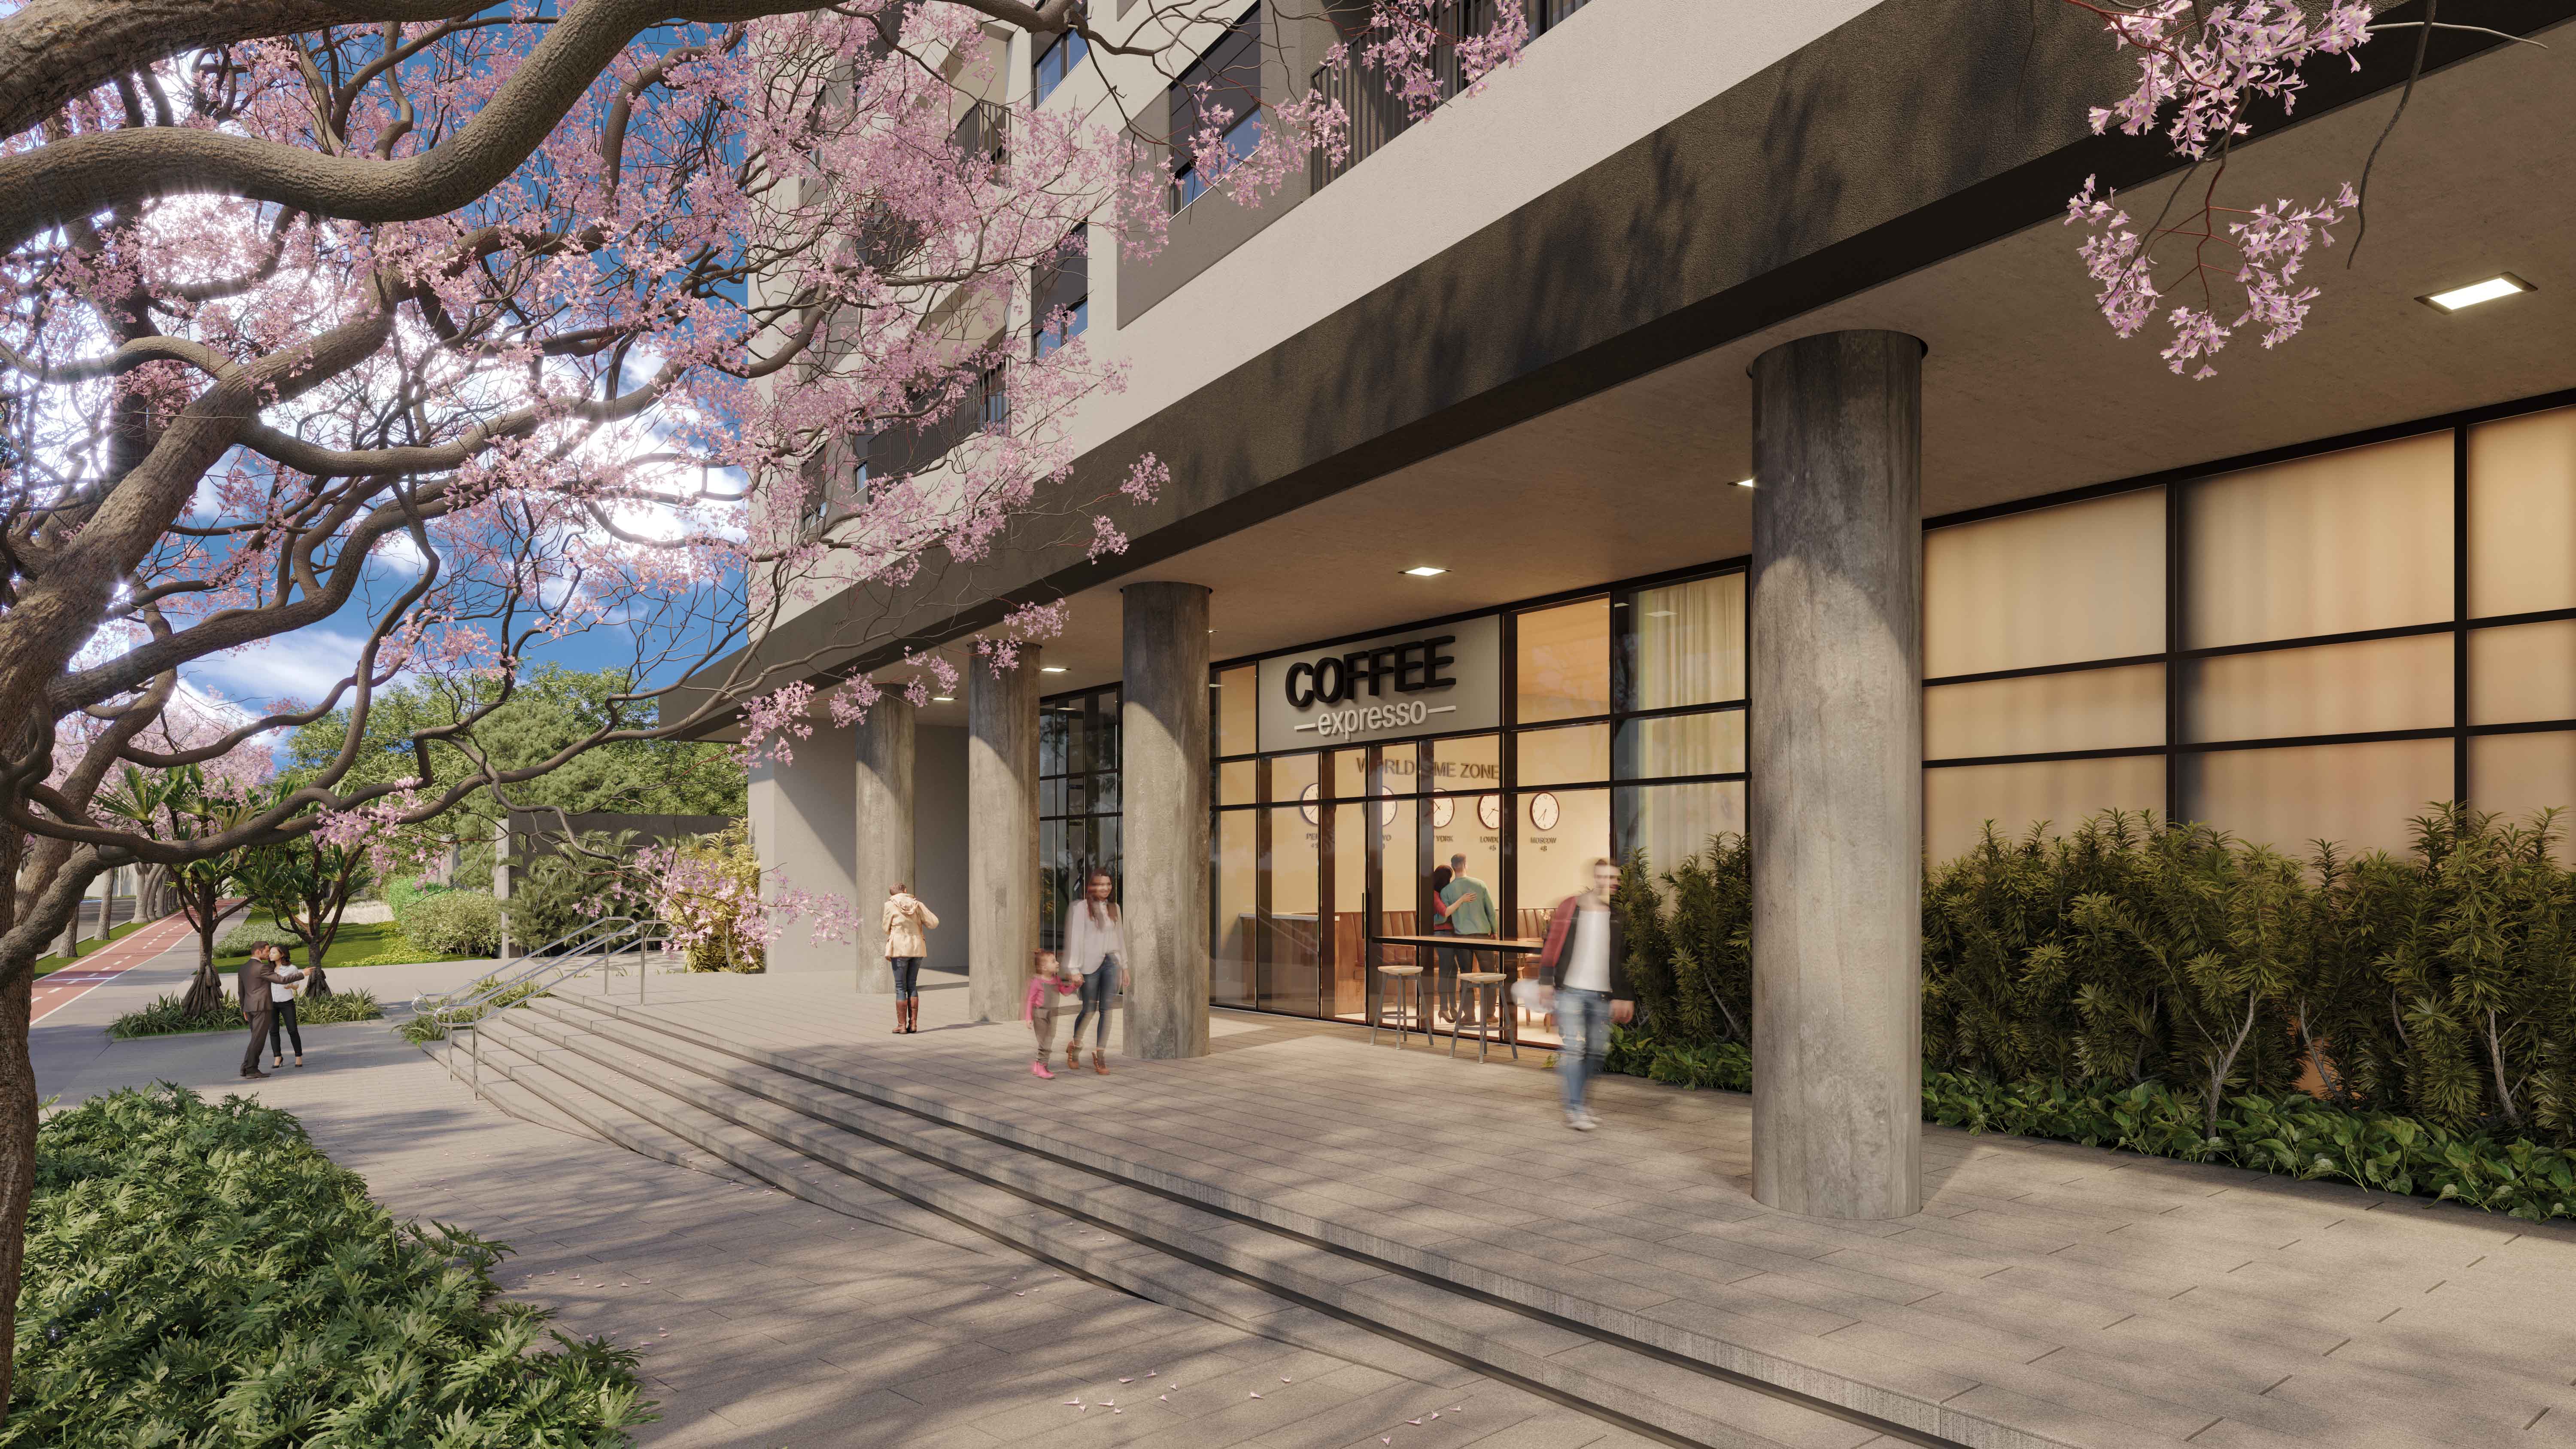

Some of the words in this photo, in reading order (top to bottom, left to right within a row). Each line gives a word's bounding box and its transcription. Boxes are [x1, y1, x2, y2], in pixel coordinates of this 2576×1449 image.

[1285, 635, 1456, 707] COFFEE
[1318, 700, 1427, 740] expresso
[1356, 758, 1415, 775] WRLD
[1434, 762, 1456, 778] ME
[1460, 763, 1499, 779] ZONE
